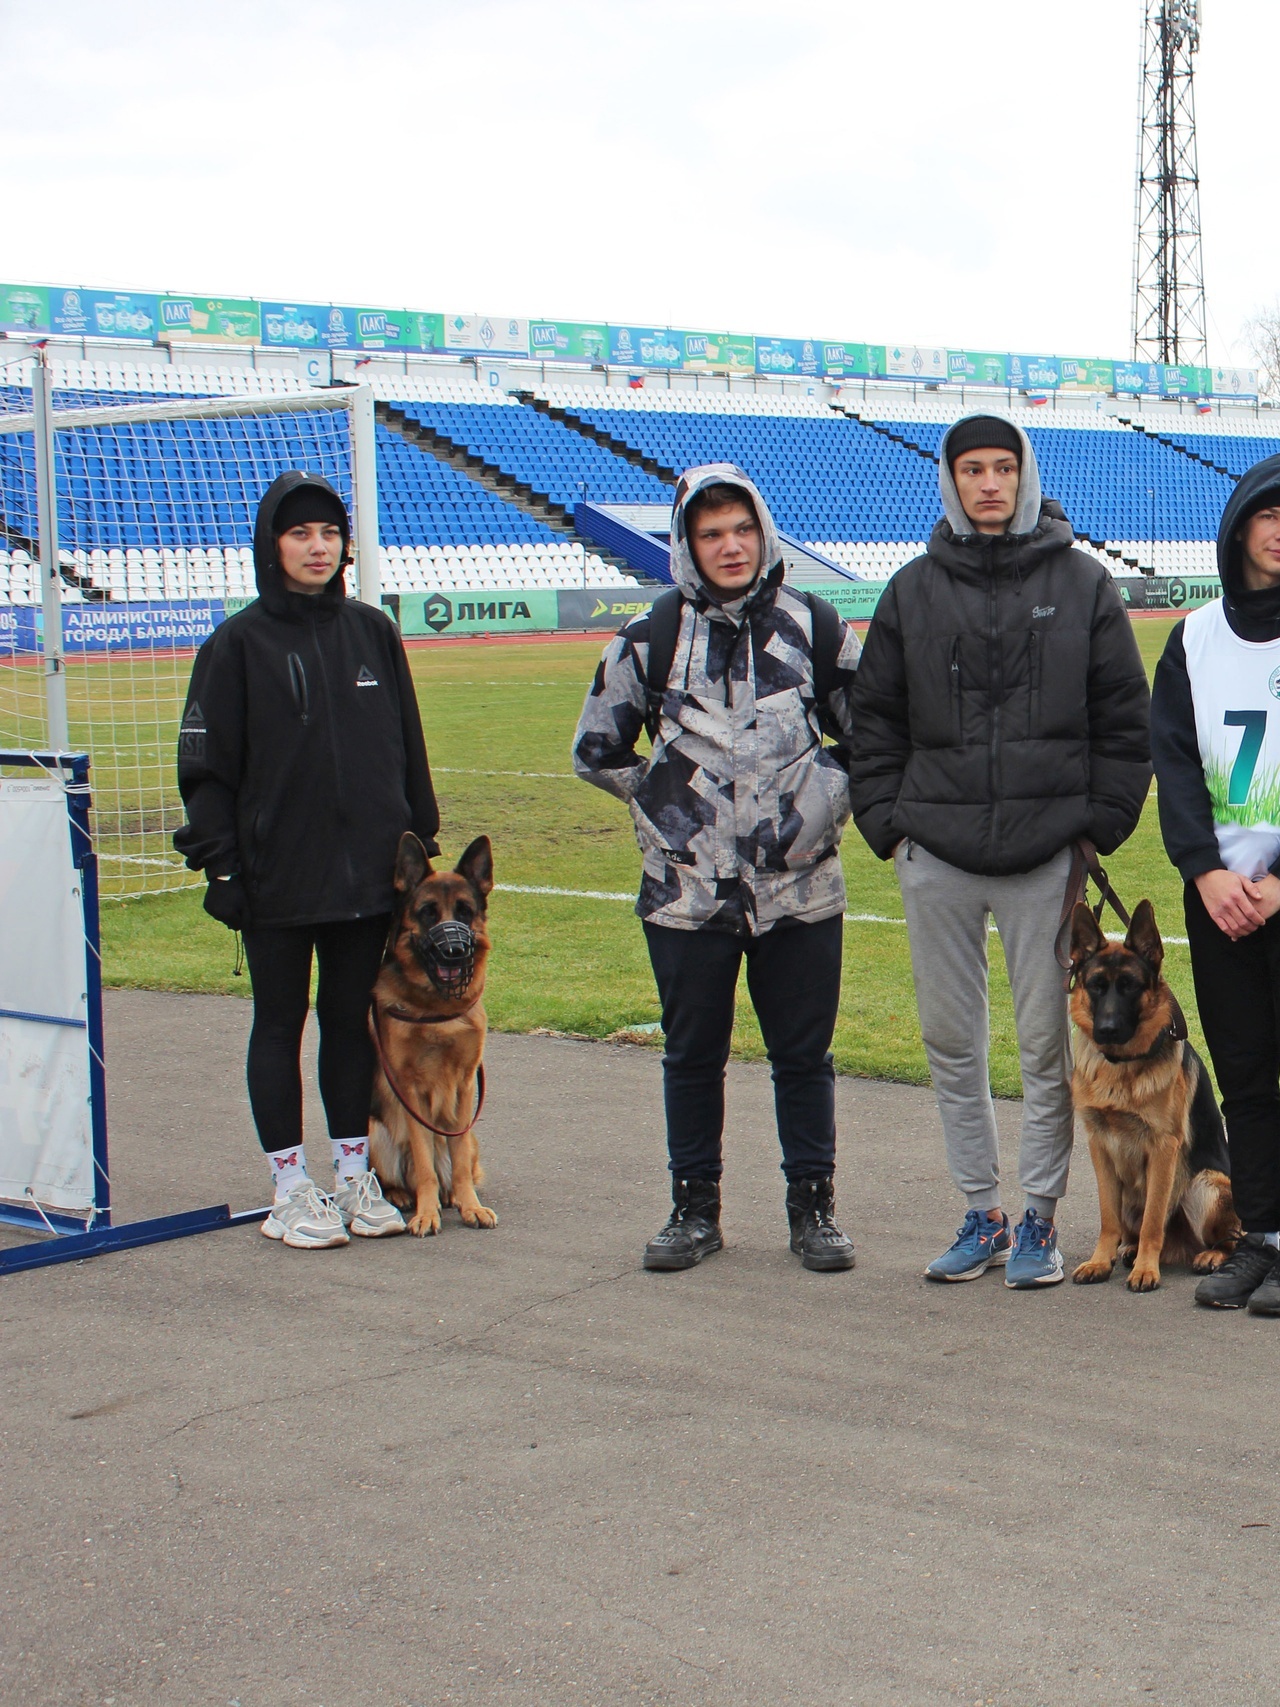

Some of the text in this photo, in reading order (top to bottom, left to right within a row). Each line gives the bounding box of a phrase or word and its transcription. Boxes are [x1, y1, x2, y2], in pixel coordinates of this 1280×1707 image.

[831, 596, 857, 605] ВТОРОЙ
[841, 588, 850, 596] ПО
[1172, 584, 1184, 600] 2
[68, 608, 212, 628] АДМИНИСТРАЦИЯ
[428, 600, 532, 622] 2 ЛИГА
[65, 623, 215, 644] ГОРОДА БАРНАУЛА
[1223, 710, 1268, 805] 7
